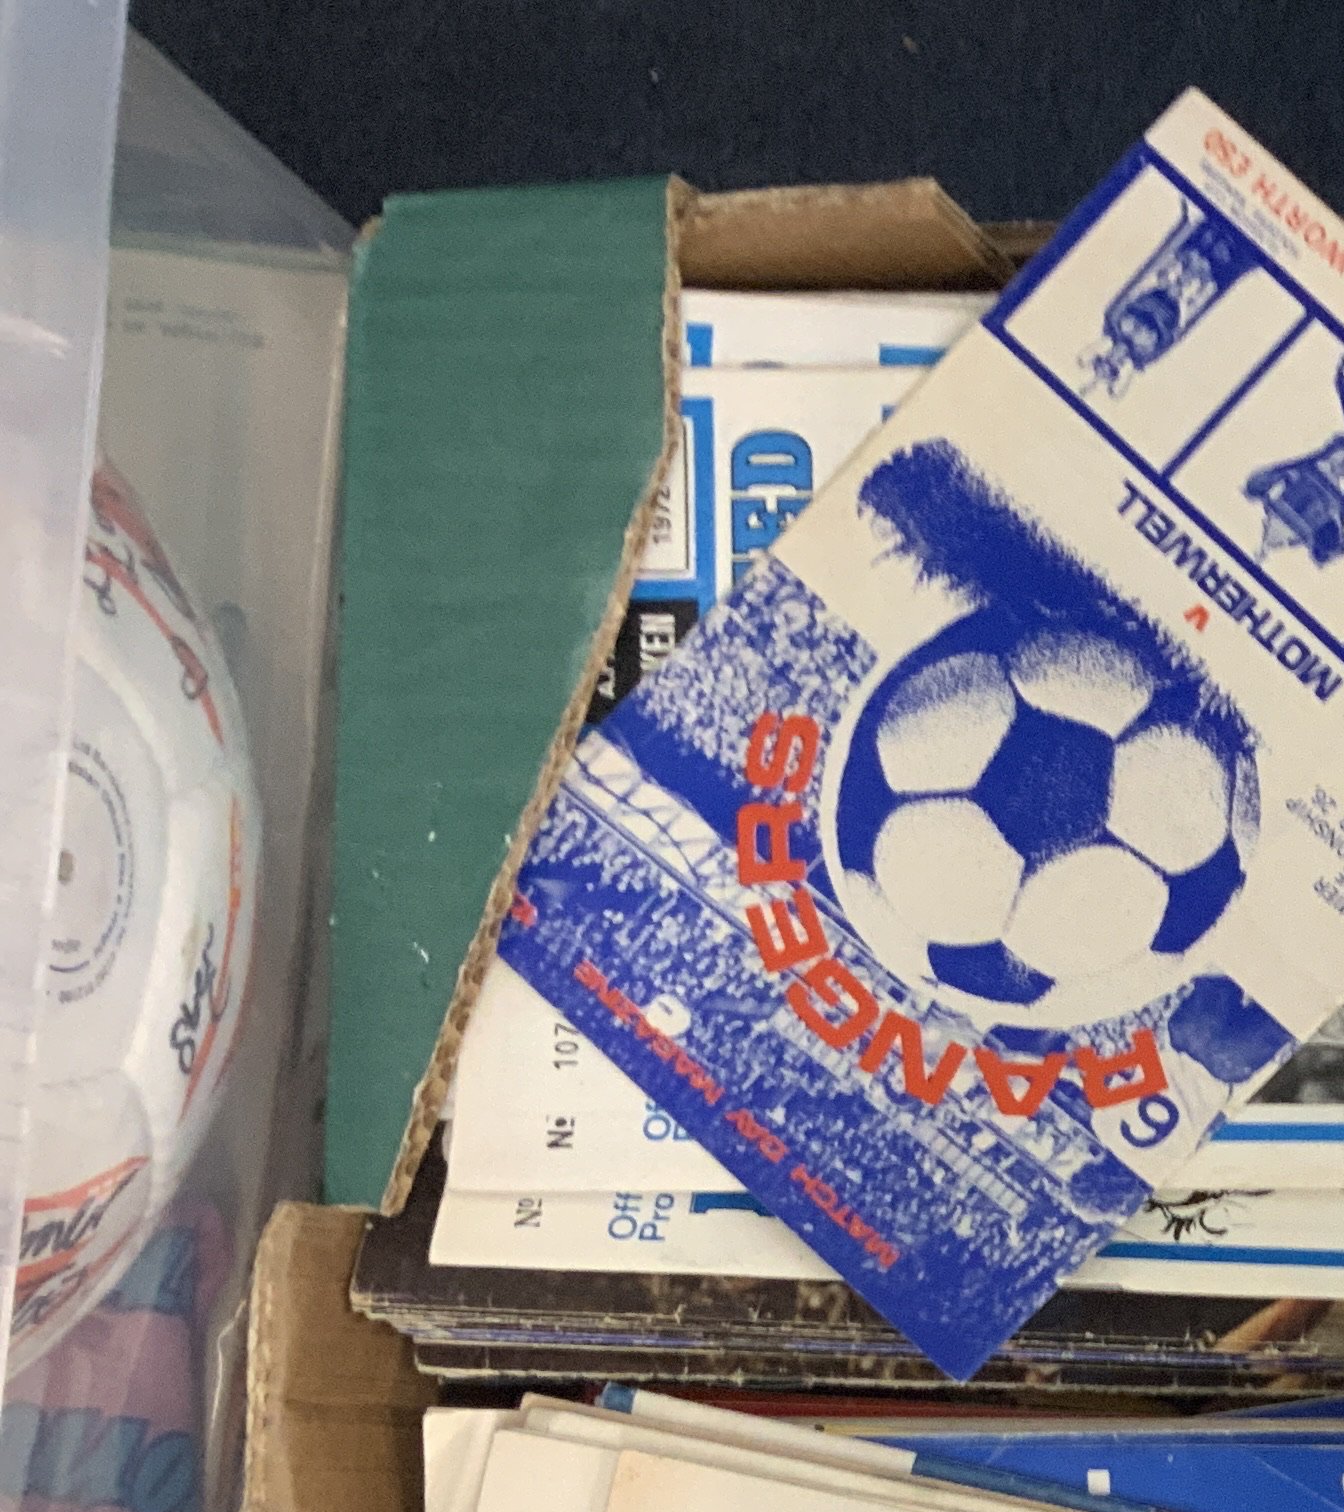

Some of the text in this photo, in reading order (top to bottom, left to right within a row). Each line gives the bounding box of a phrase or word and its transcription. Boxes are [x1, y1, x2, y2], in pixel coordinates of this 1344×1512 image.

[1115, 476, 1344, 703] MOTHERWELL
[736, 709, 1171, 1119] RANGERS
[574, 960, 901, 1269] MATCH DAY MAGAZINE
